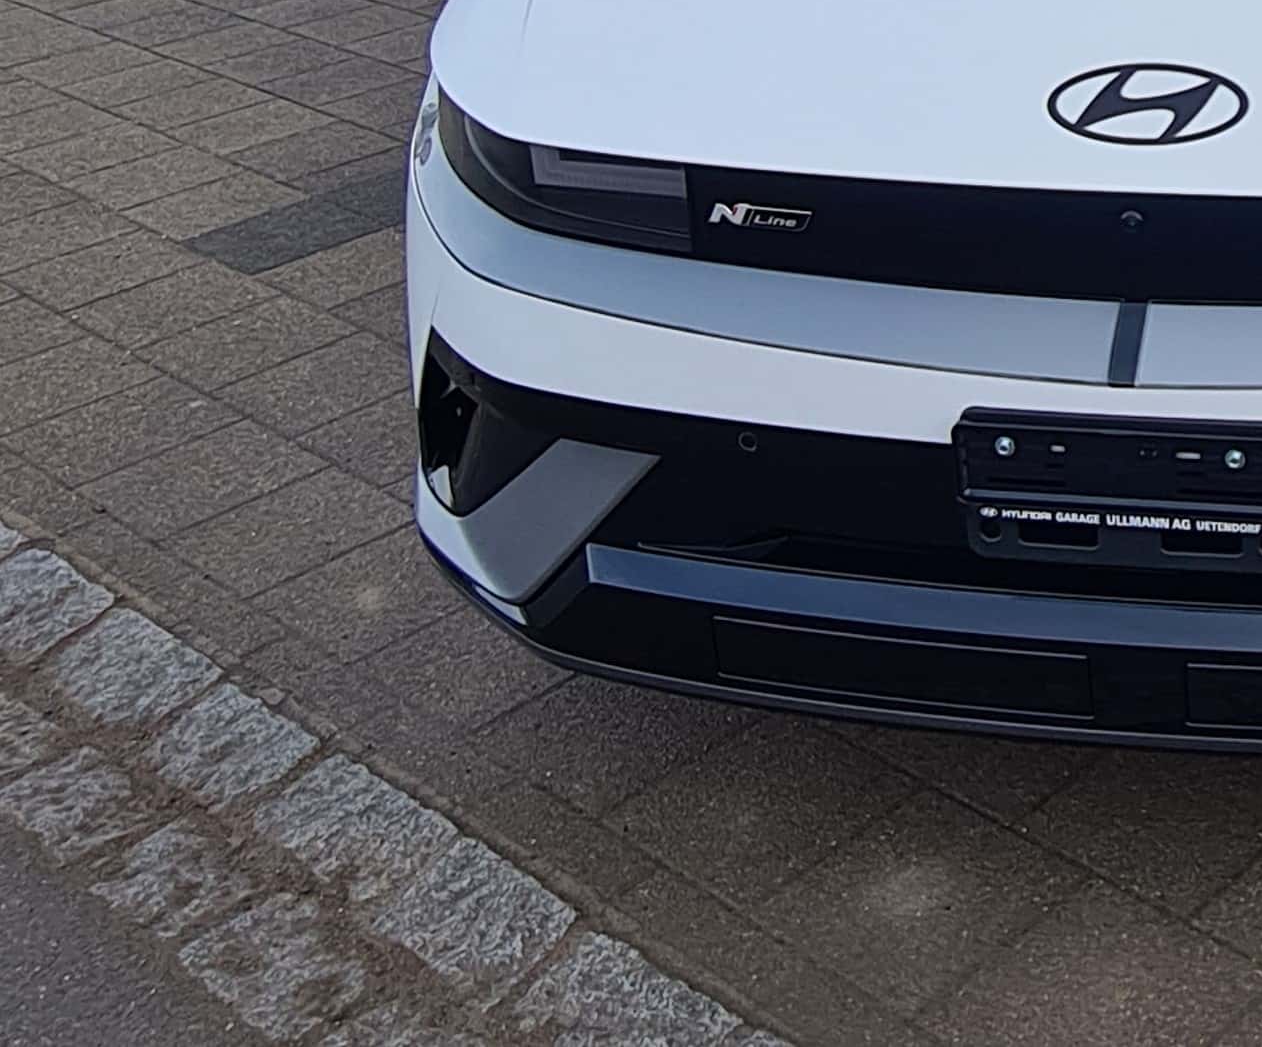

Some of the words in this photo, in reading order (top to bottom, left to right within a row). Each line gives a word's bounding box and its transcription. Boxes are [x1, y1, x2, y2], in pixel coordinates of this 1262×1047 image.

[708, 202, 750, 226] N
[753, 214, 798, 227] Line
[1001, 509, 1052, 521] HYUNDAI
[1055, 512, 1100, 525] GARAGE
[1106, 514, 1170, 530] ULLMANN
[1171, 518, 1191, 531] AG
